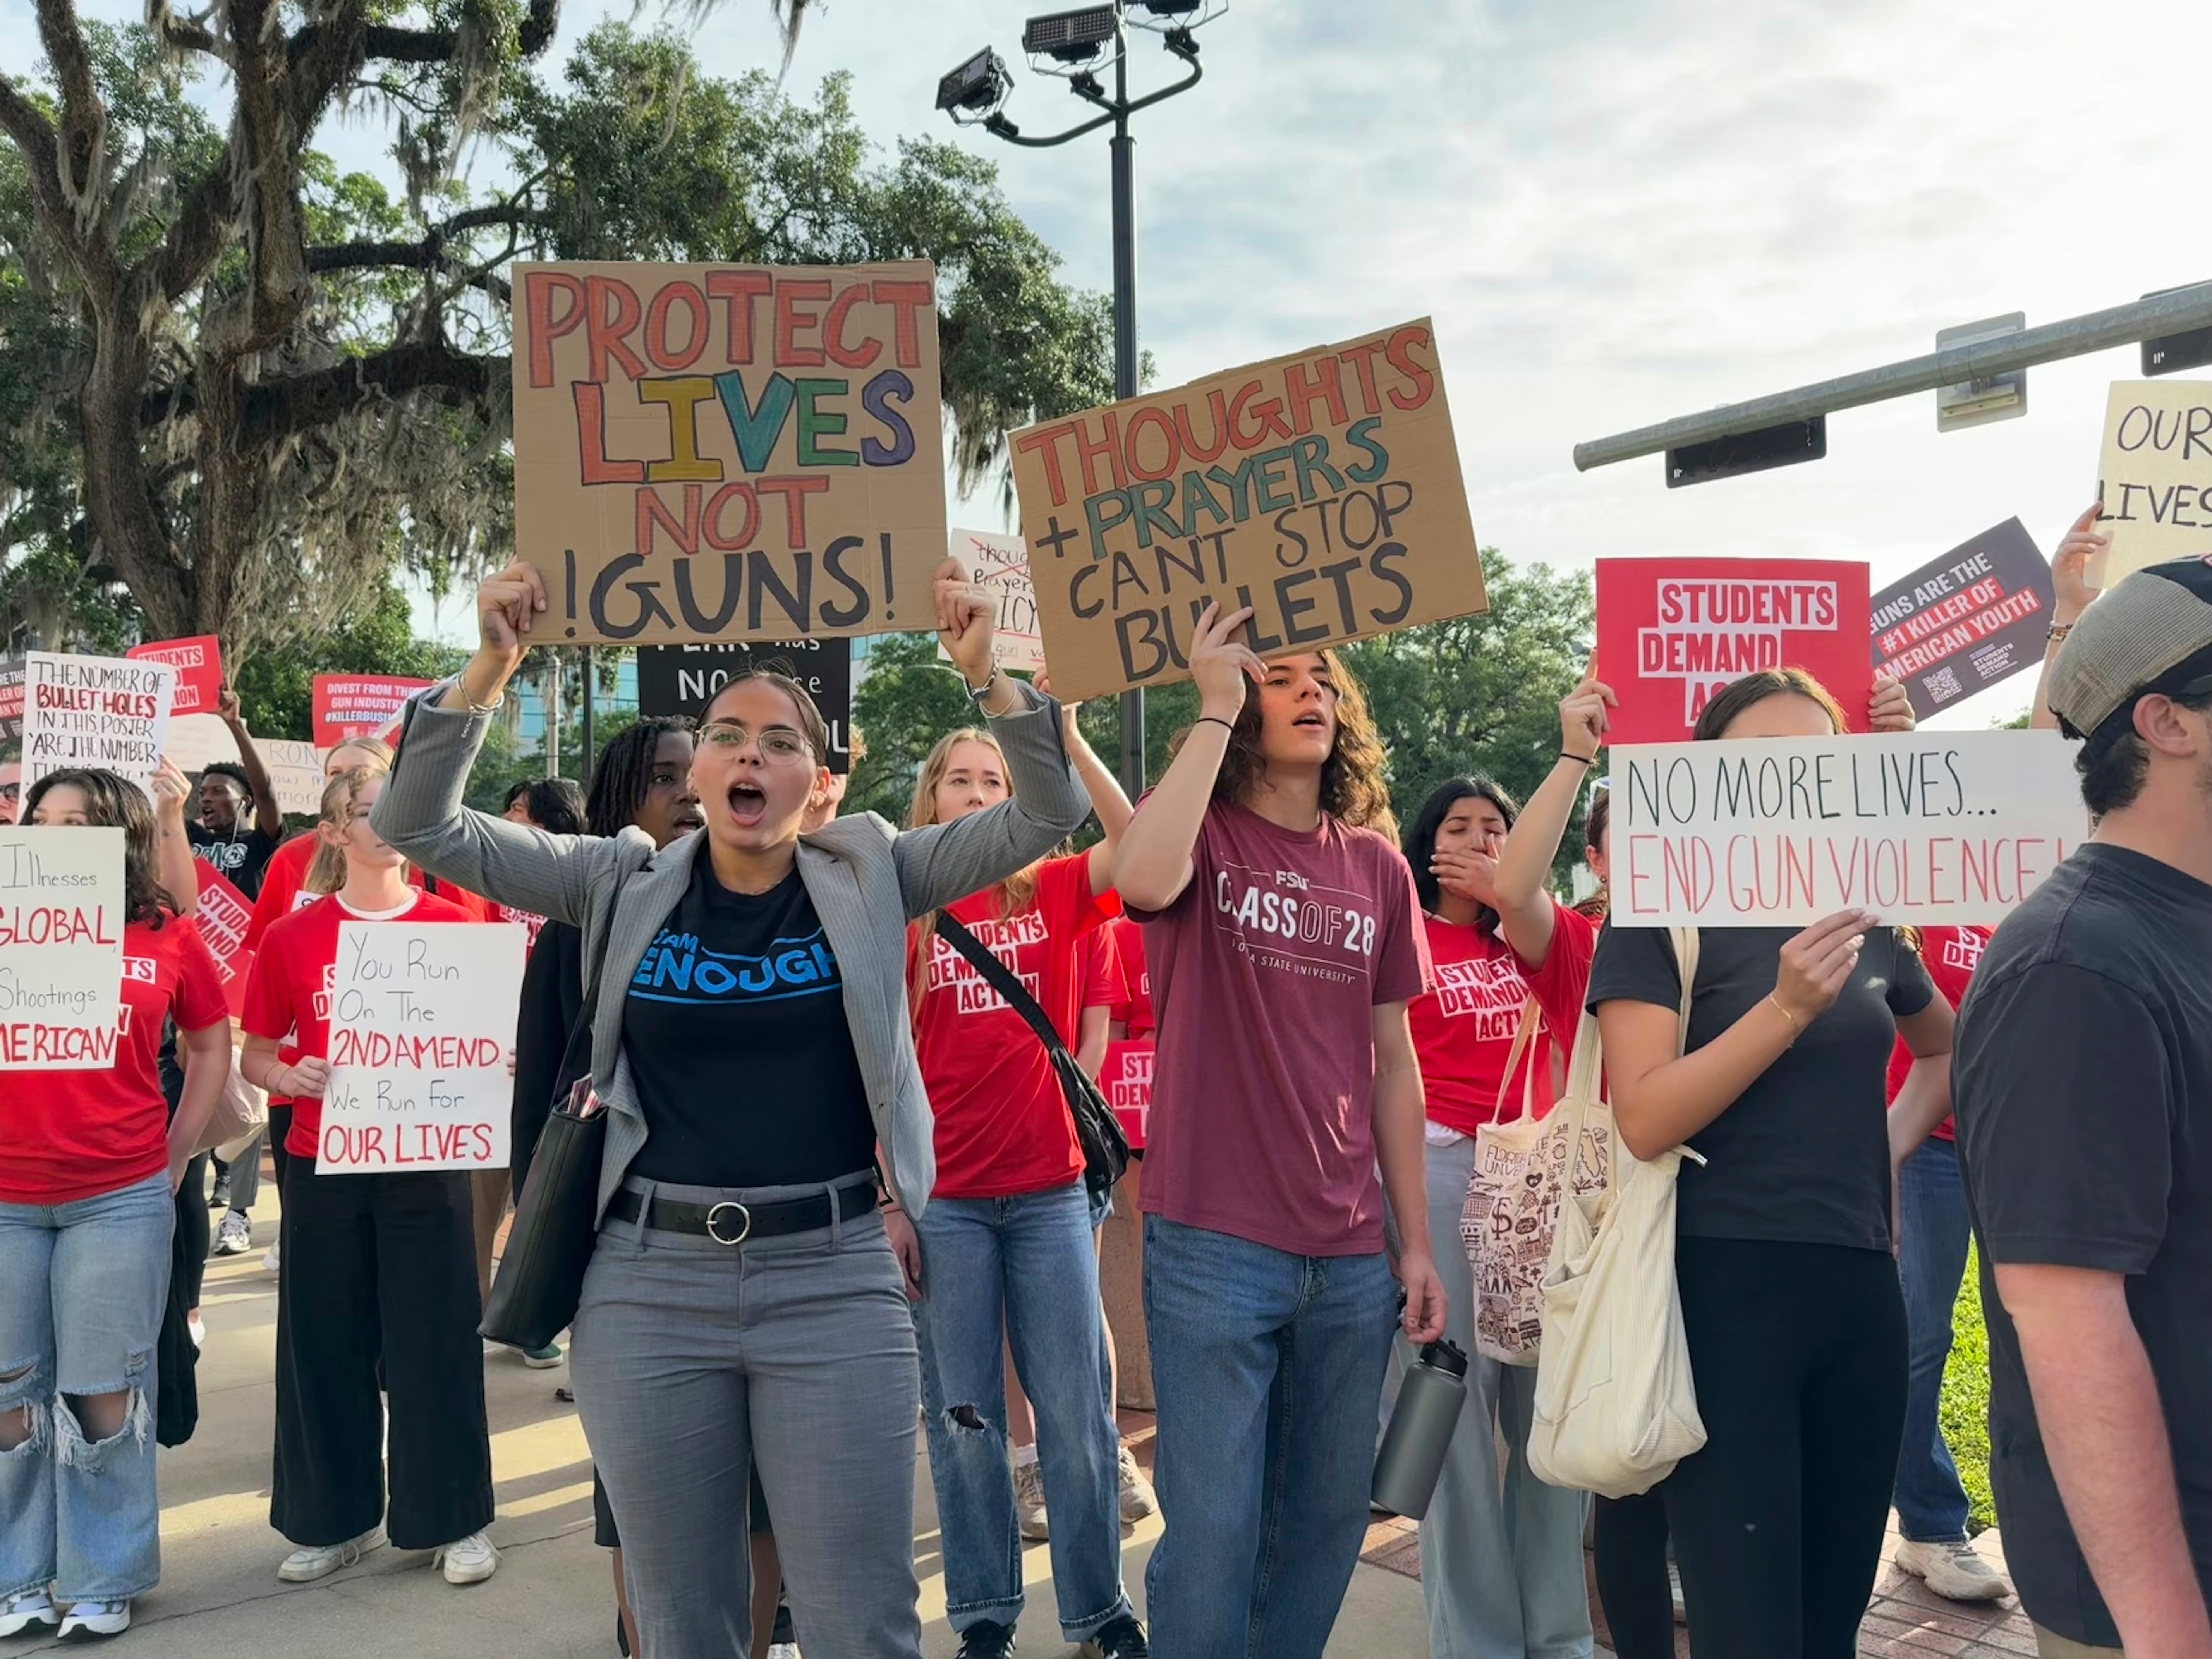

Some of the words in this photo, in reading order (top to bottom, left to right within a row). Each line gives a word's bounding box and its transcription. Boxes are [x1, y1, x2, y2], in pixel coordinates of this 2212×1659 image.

[525, 270, 933, 387] PROTECT
[572, 369, 916, 485] LIVES
[1017, 326, 1435, 506] THOUGHTS
[2118, 406, 2212, 460] OUR
[1036, 517, 1078, 558] +
[1084, 416, 1389, 560] PRAYERS
[2096, 480, 2212, 528] LIVES
[635, 475, 830, 555] NOT
[1274, 481, 1412, 567] STOP
[1913, 574, 1954, 607] ARE
[1949, 552, 1993, 585] THE
[1115, 543, 1413, 683] BULETS
[1661, 583, 1834, 625] STUDENTS
[1882, 629, 1907, 653] #1
[1907, 597, 1973, 643] KILLER
[1970, 579, 1999, 607] OF
[1643, 633, 1778, 672] DEMAND
[1874, 620, 1972, 680] AMERICAN
[1969, 591, 2038, 637] YOUTH
[32, 661, 76, 686] THE
[80, 665, 139, 692] NUMBER
[143, 671, 168, 694] OF
[36, 684, 100, 710] BULLET
[103, 693, 157, 719] HOLES
[327, 683, 361, 694] DIVEST
[363, 684, 392, 694] FROM
[37, 711, 55, 728] IN
[61, 713, 97, 733] THIS
[101, 716, 154, 739] POSTER
[331, 698, 352, 708] GUN
[32, 733, 64, 756] ARE
[68, 737, 98, 757] THE
[100, 739, 156, 762] NUMBER
[1628, 757, 1696, 826] NO
[1714, 754, 1841, 821] MORE
[1853, 750, 1997, 818] LIVES...
[2, 844, 97, 888] Illnesses
[1275, 870, 1309, 890] FSU
[1629, 835, 1715, 915] END
[1727, 834, 1814, 913] GUN
[349, 932, 392, 981] You
[407, 939, 460, 980] Run
[632, 943, 836, 994] ENOUGH
[1261, 956, 1290, 970] STATE
[1294, 964, 1355, 984] UNIVERSITY
[0, 967, 97, 1015] Shootings
[338, 989, 375, 1022] On
[386, 991, 436, 1022] The
[1440, 980, 1523, 1014] DEMAND
[330, 1082, 360, 1111] We
[378, 1080, 416, 1111] Run
[429, 1080, 464, 1108] For
[323, 1125, 386, 1164] OUR
